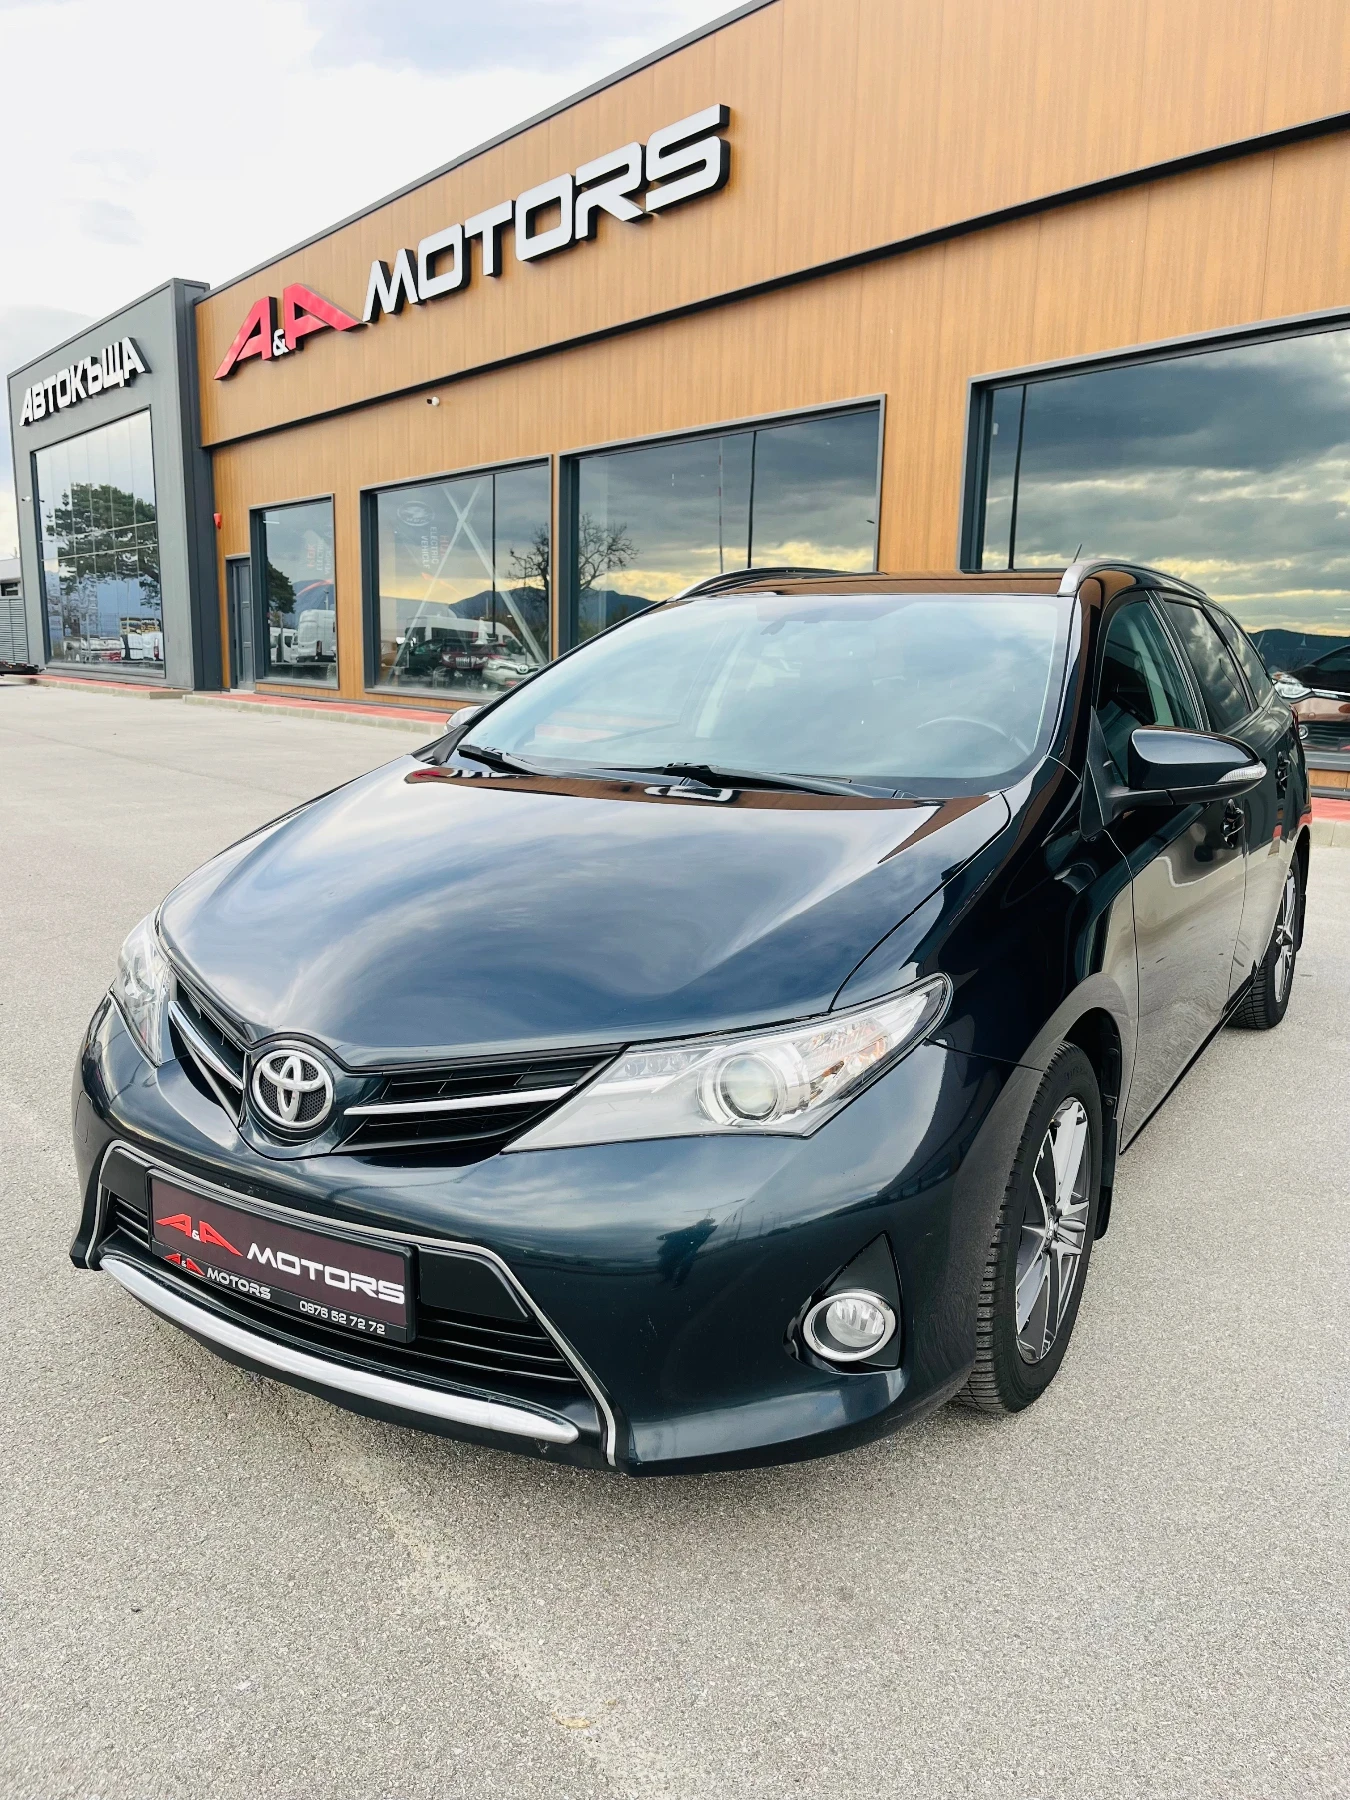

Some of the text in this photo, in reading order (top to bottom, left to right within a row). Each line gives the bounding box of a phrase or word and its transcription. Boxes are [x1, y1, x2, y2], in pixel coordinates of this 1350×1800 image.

[213, 103, 729, 381] A&A MOTORS
[19, 337, 148, 426] АВТОКЪЩА
[430, 526, 440, 565] ELECTRIC
[155, 1213, 405, 1305] A&A MOTORS
[206, 1267, 271, 1300] MOTORS
[349, 1315, 366, 1330] 72
[368, 1320, 386, 1335] 72
